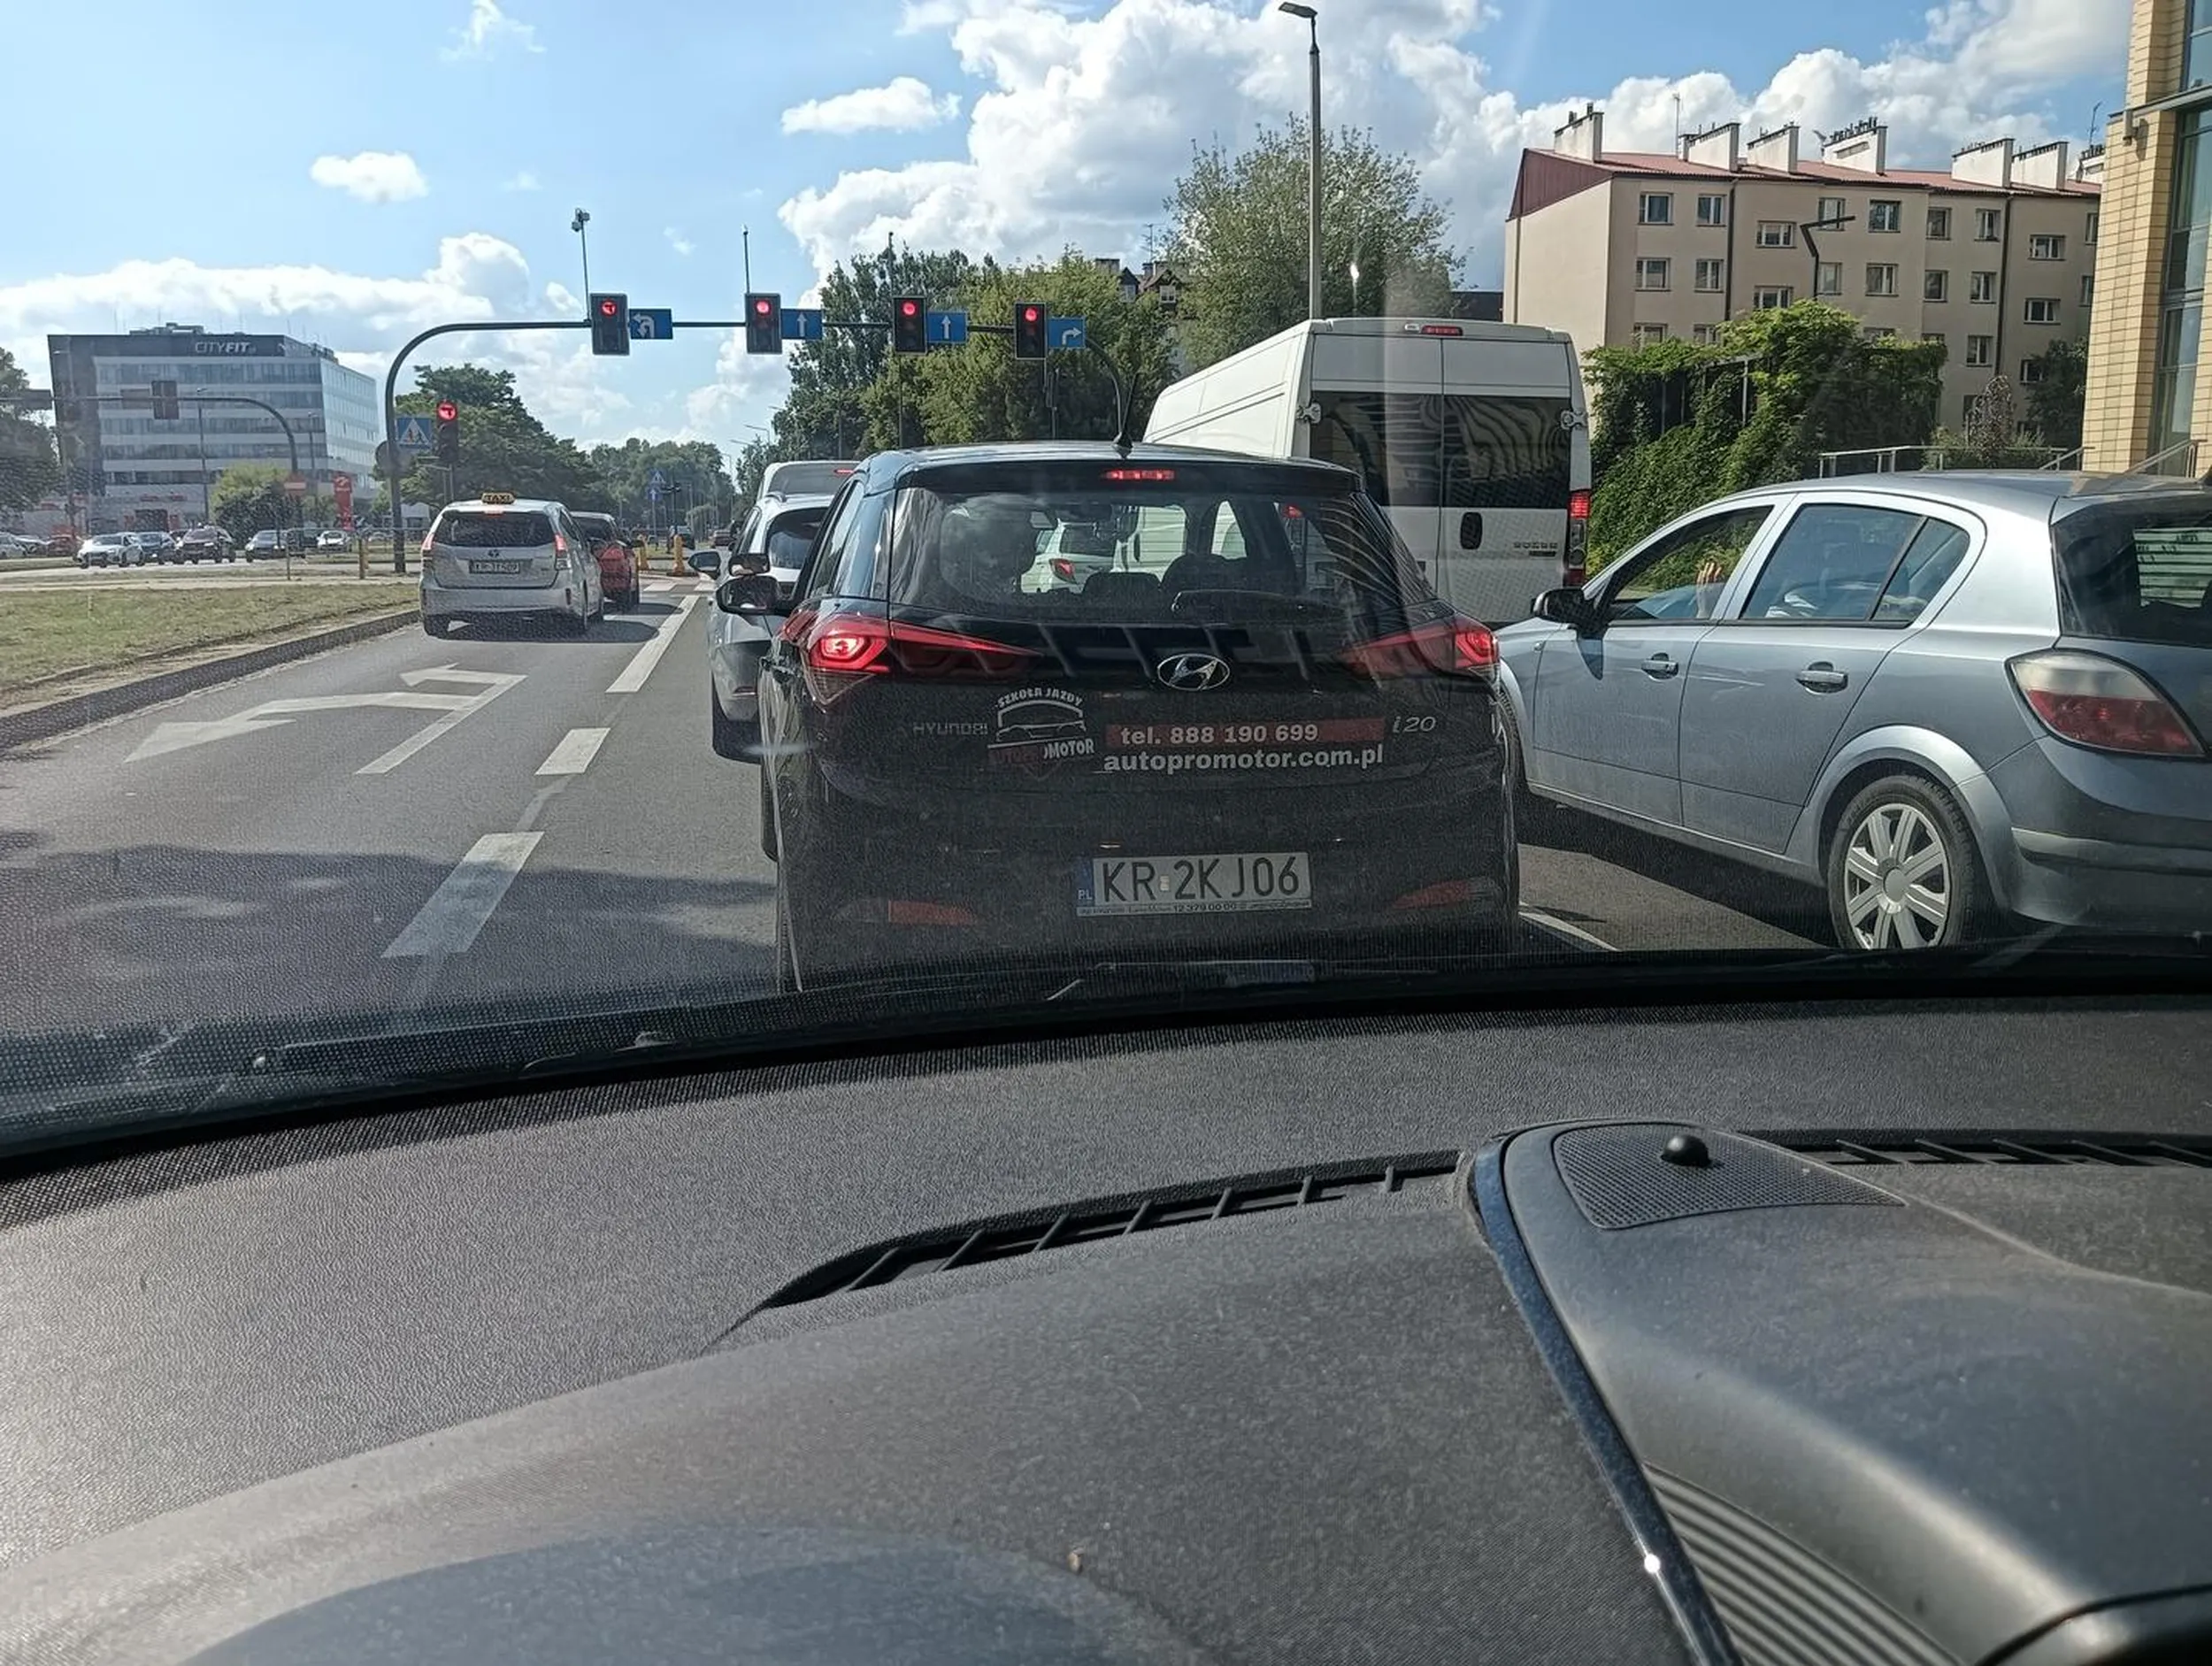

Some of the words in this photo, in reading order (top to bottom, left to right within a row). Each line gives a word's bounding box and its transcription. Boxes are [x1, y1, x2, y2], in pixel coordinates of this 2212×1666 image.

[195, 342, 251, 353] CITYFIT
[997, 687, 1043, 709] SZKOŁA
[1044, 687, 1083, 707] JAZDY
[1120, 726, 1162, 745] tel.
[1169, 726, 1216, 745] 888
[1224, 725, 1268, 743] 190
[1275, 724, 1318, 741] 699
[1392, 716, 1437, 733] i20
[1103, 743, 1384, 775] autopromotor.com.pl
[1102, 861, 1156, 902] KR
[1172, 856, 1300, 901] 2KJ06
[1078, 888, 1094, 901] PL
